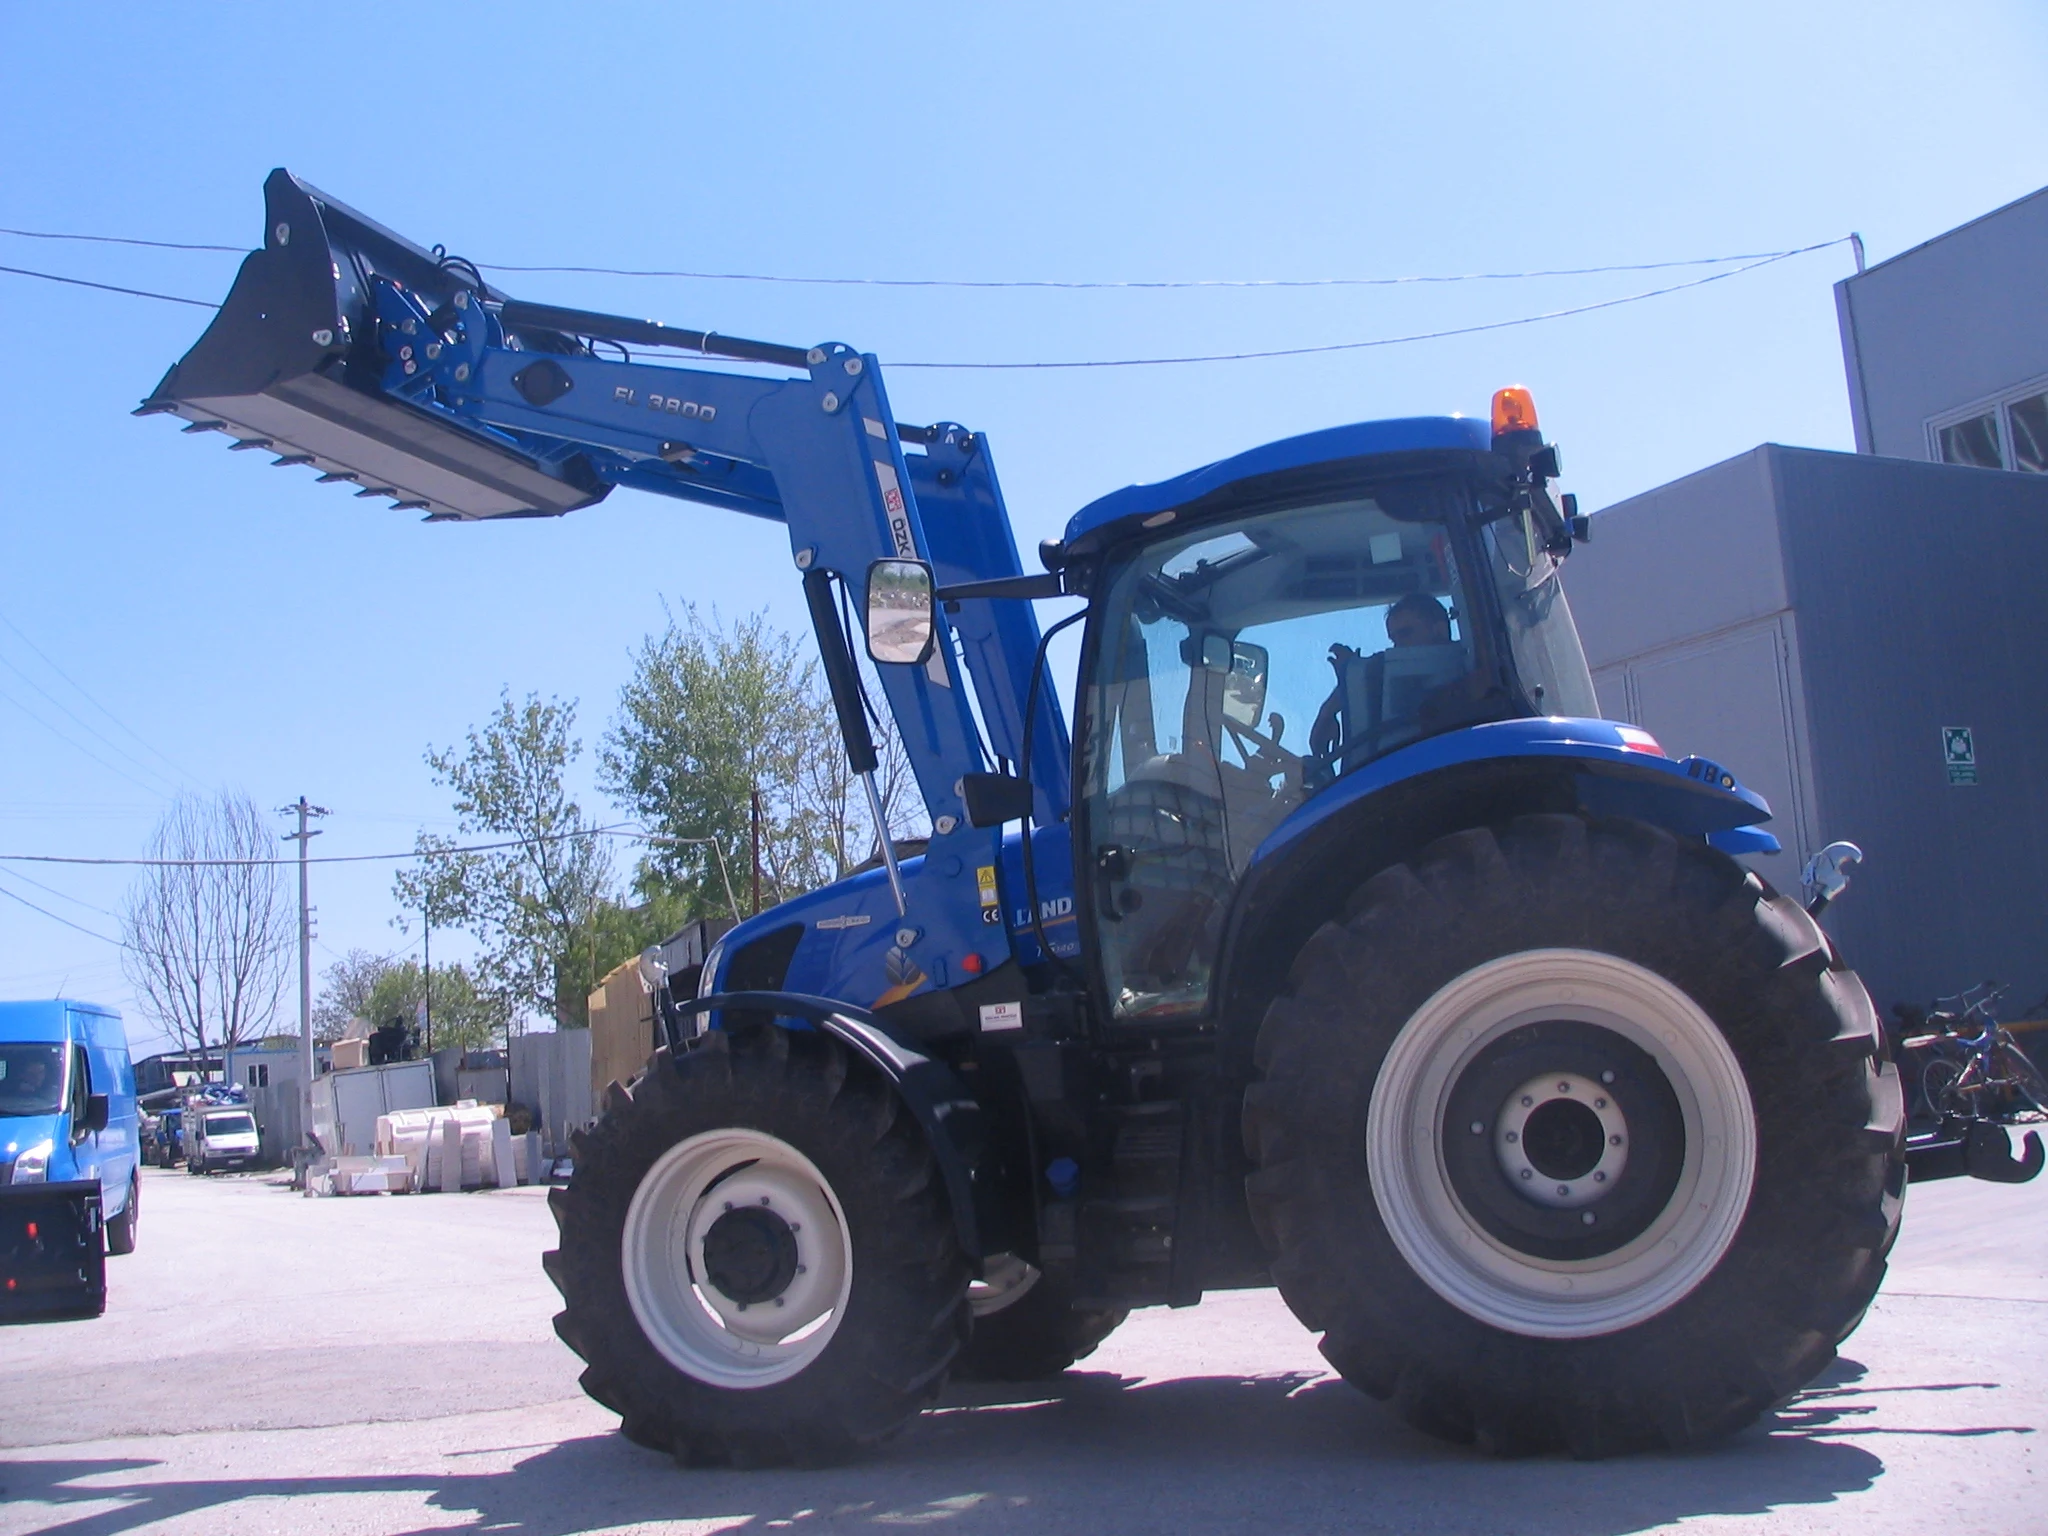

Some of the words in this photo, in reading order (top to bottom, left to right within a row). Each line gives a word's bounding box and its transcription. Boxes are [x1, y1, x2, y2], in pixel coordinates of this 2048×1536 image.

[614, 387, 636, 405] FL
[648, 394, 717, 422] 3800
[892, 518, 914, 558] ÖZK
[983, 909, 999, 923] CE
[1013, 897, 1073, 927] LAND
